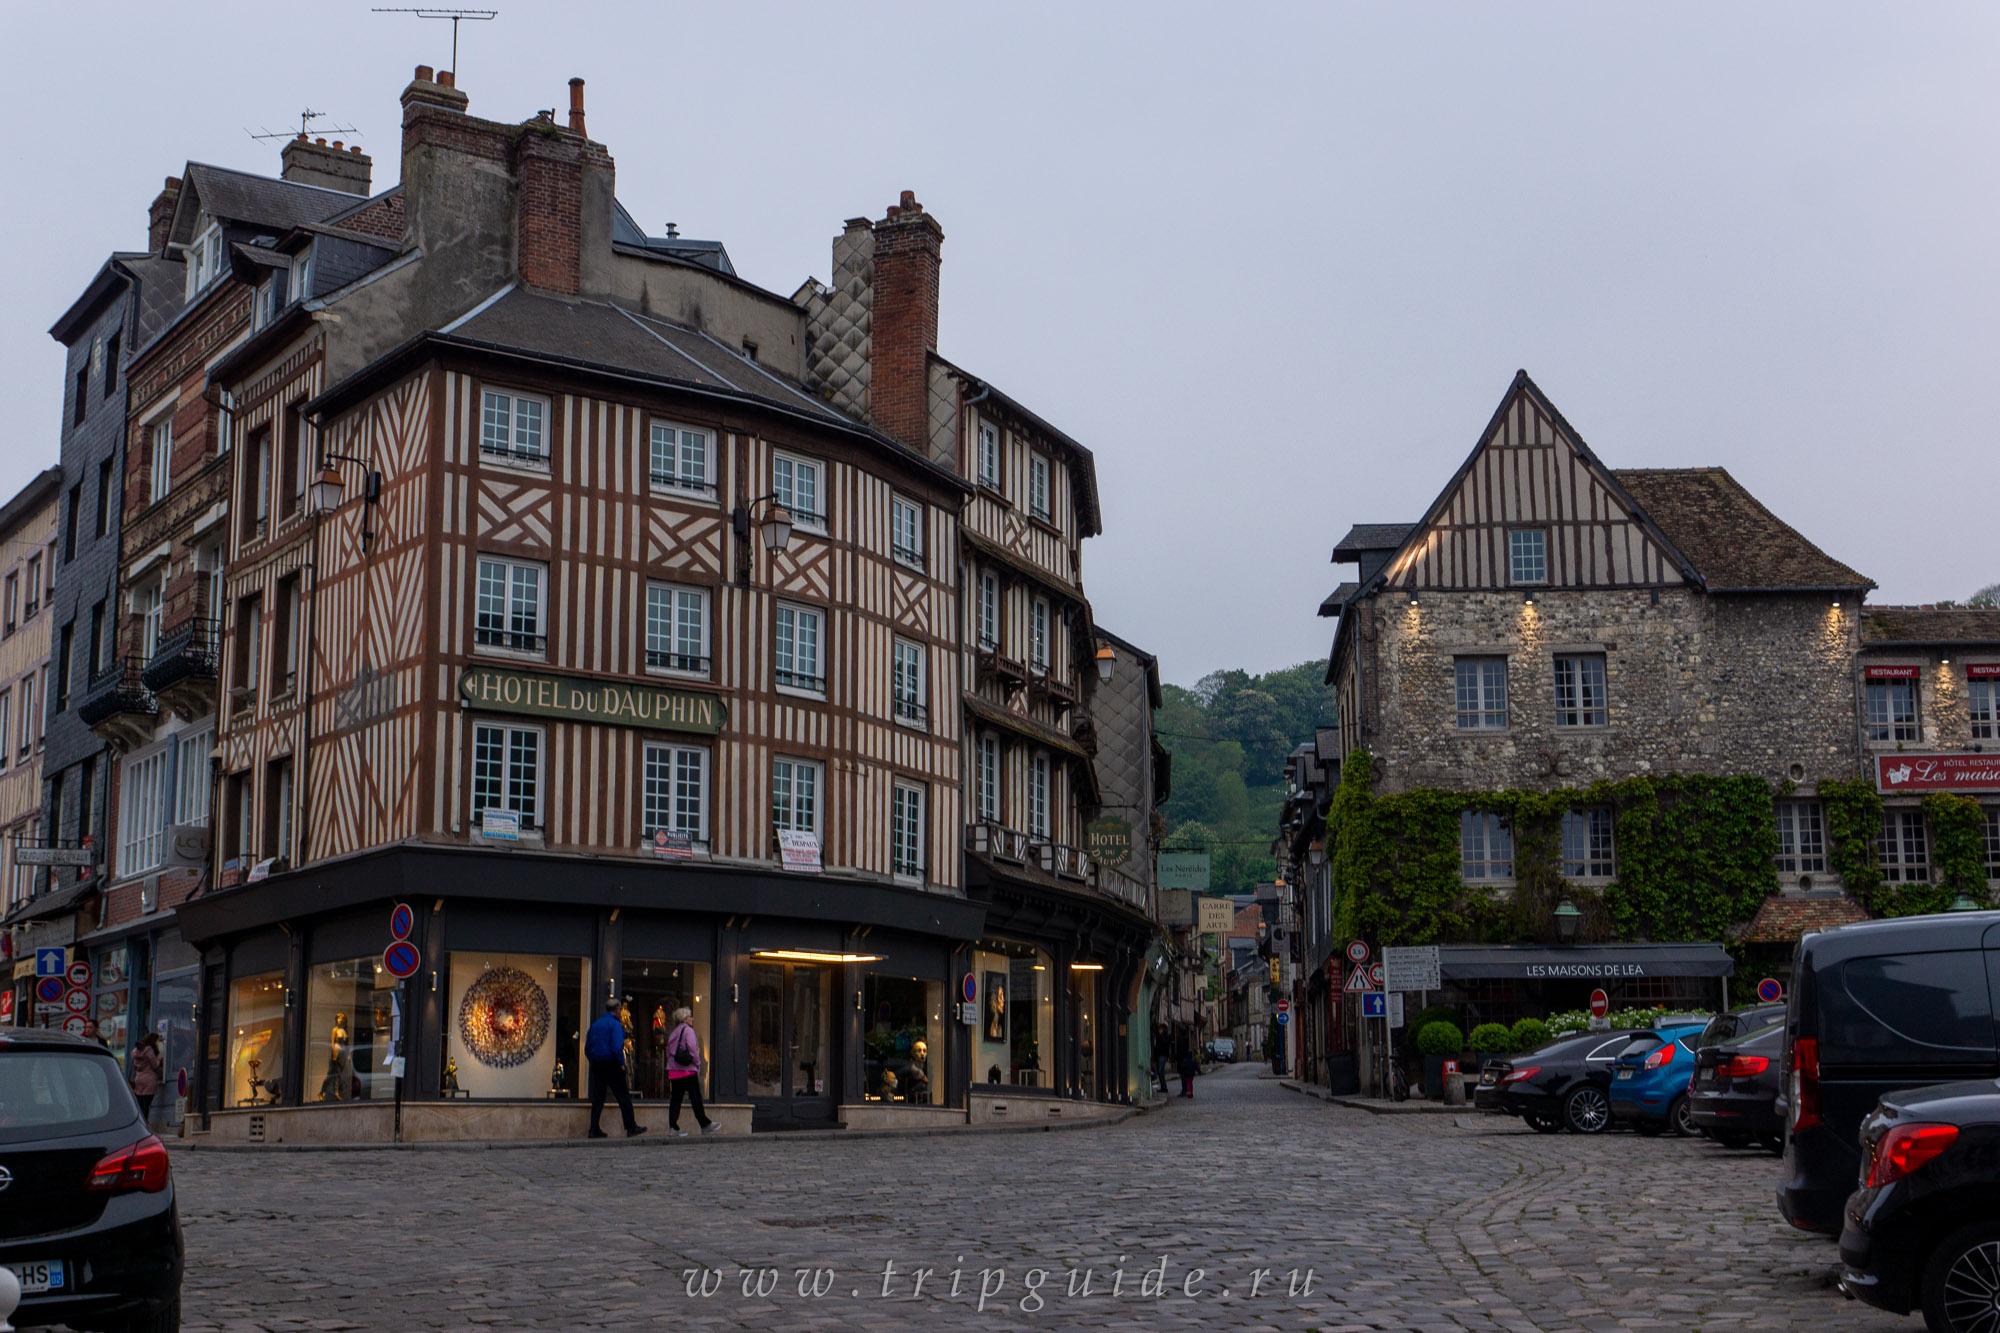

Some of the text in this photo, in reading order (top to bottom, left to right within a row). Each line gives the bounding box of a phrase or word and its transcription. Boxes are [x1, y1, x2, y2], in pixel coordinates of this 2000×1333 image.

[480, 673, 713, 726] HOTEL DU DAUPHIN
[1943, 759, 1967, 767] HÔTEL
[1913, 760, 1947, 782] Les
[791, 839, 818, 849] DESPAUX
[1090, 832, 1130, 846] HOTEL
[1091, 848, 1129, 866] DAUPHIN
[1161, 864, 1173, 873] Les
[1526, 964, 1644, 976] LES MAISONS DE LEA
[51, 1275, 61, 1284] 02
